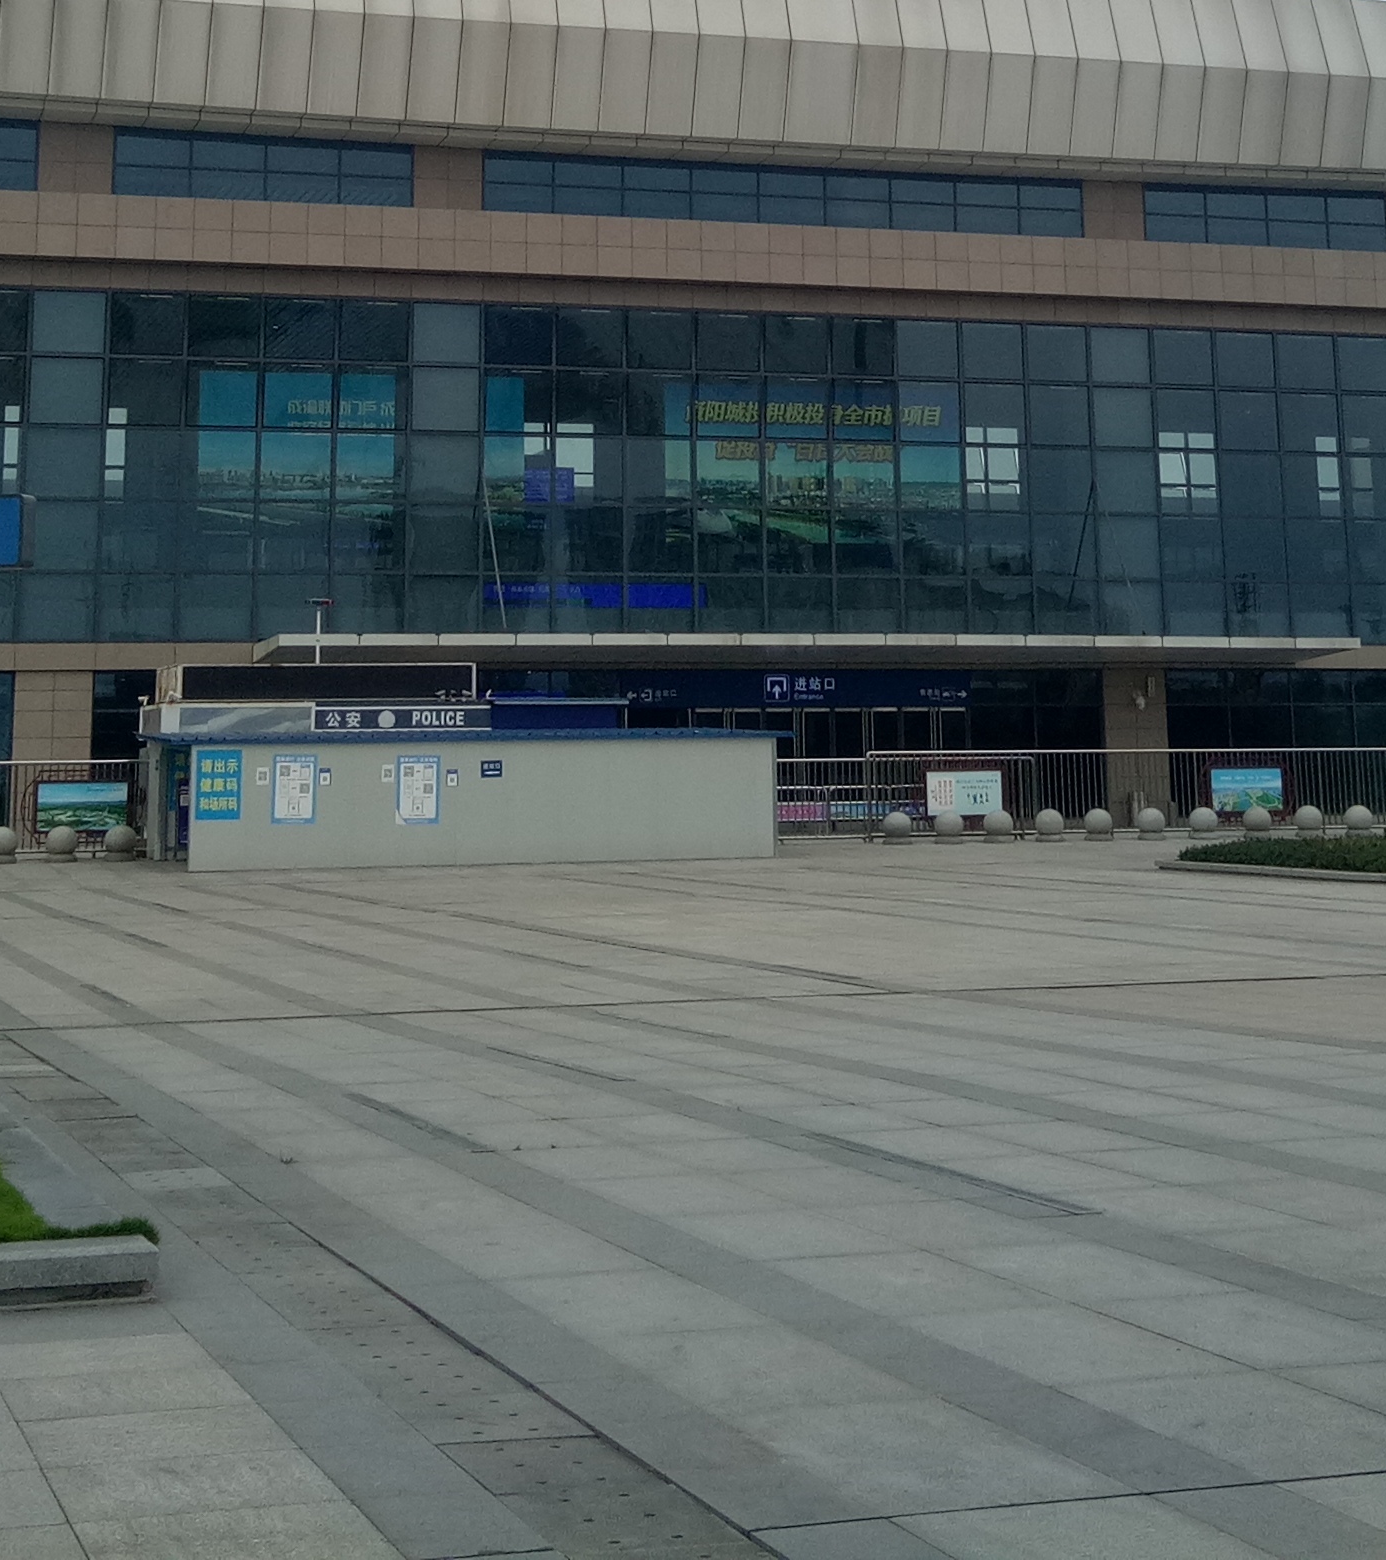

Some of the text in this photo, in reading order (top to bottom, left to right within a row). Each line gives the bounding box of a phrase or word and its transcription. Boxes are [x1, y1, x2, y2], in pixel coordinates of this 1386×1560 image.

[794, 676, 835, 691] 进站口
[325, 711, 361, 728] 公安
[412, 711, 465, 726] POLICE
[201, 759, 239, 774] 请出示
